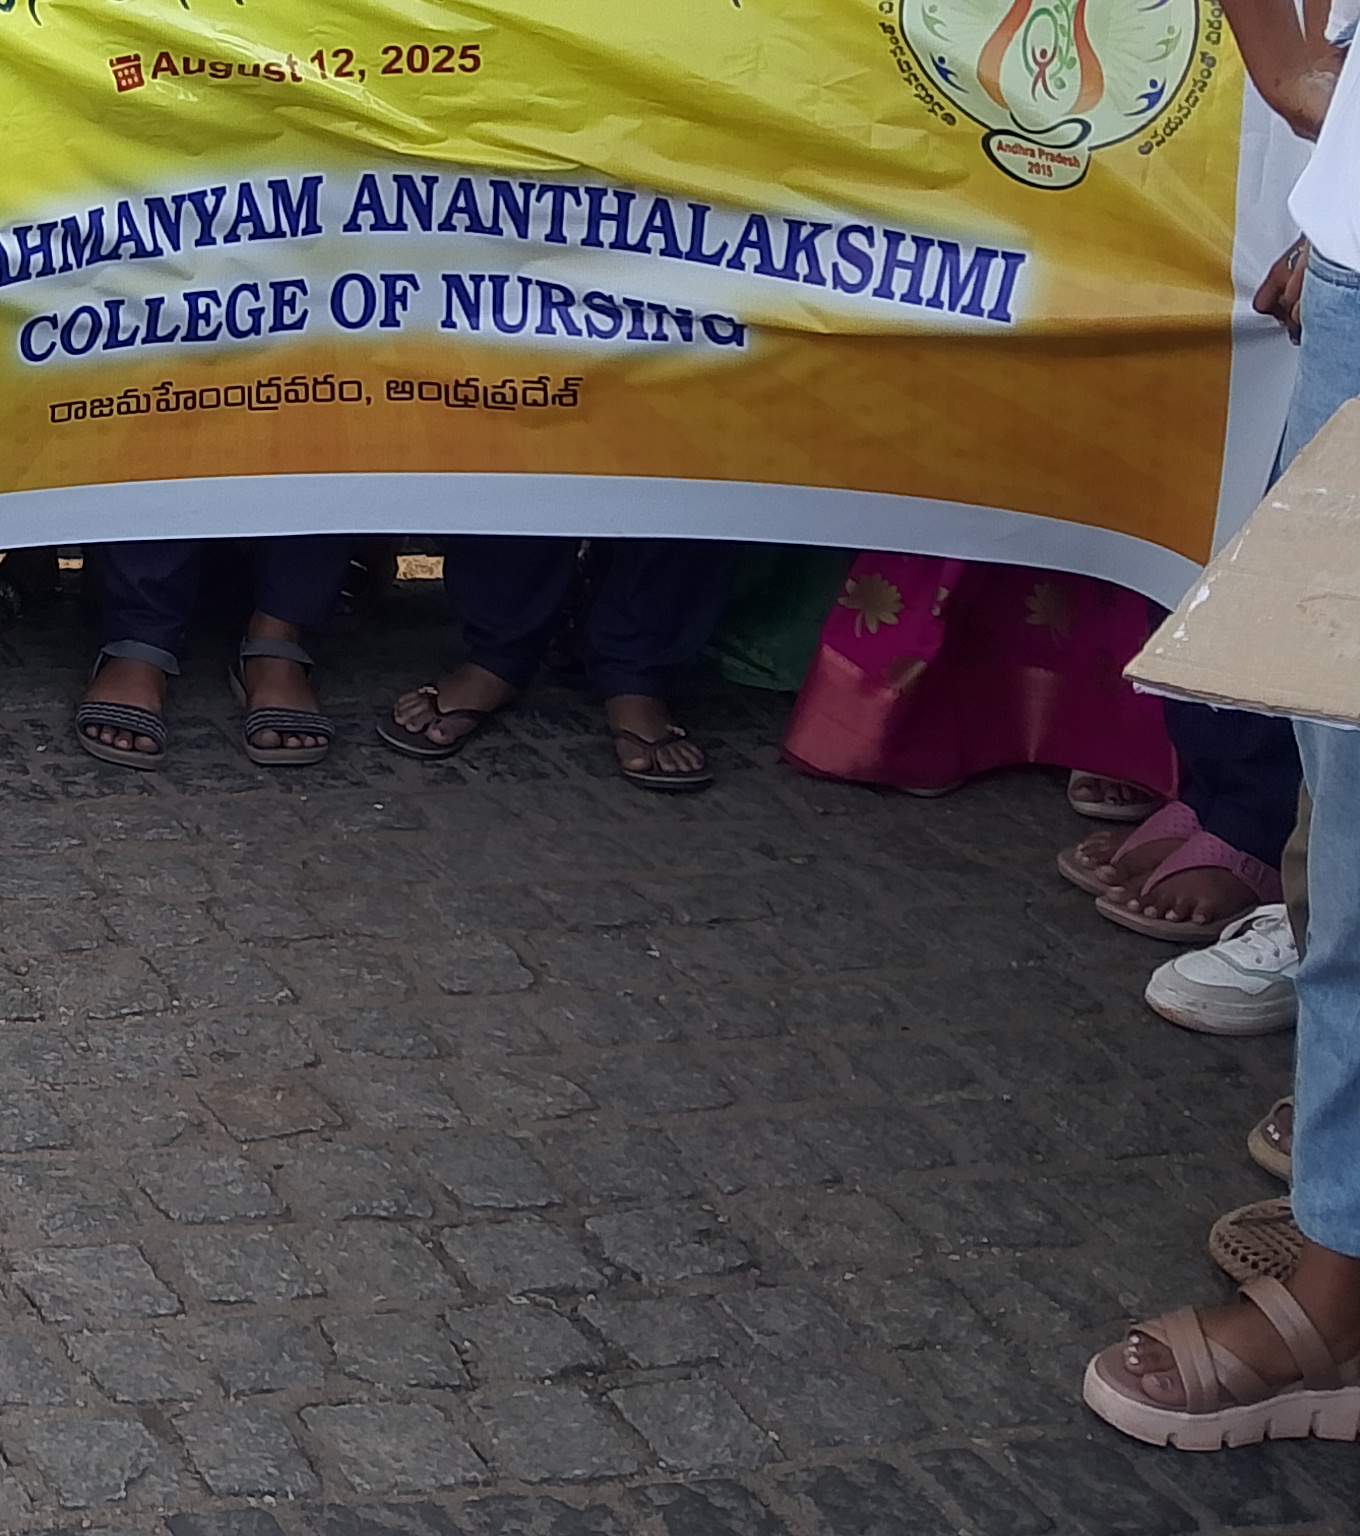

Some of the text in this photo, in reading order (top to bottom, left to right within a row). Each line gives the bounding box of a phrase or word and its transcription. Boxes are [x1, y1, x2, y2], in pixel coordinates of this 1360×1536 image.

[151, 44, 481, 83] August 12, 2025
[996, 139, 1081, 169] Andhra Pradesh
[343, 173, 1028, 325] ANANTHALAKSHMI
[19, 271, 748, 365] COLLEGE OF NURSING
[386, 375, 585, 413] ఆంధ్రప్రదేశ్
